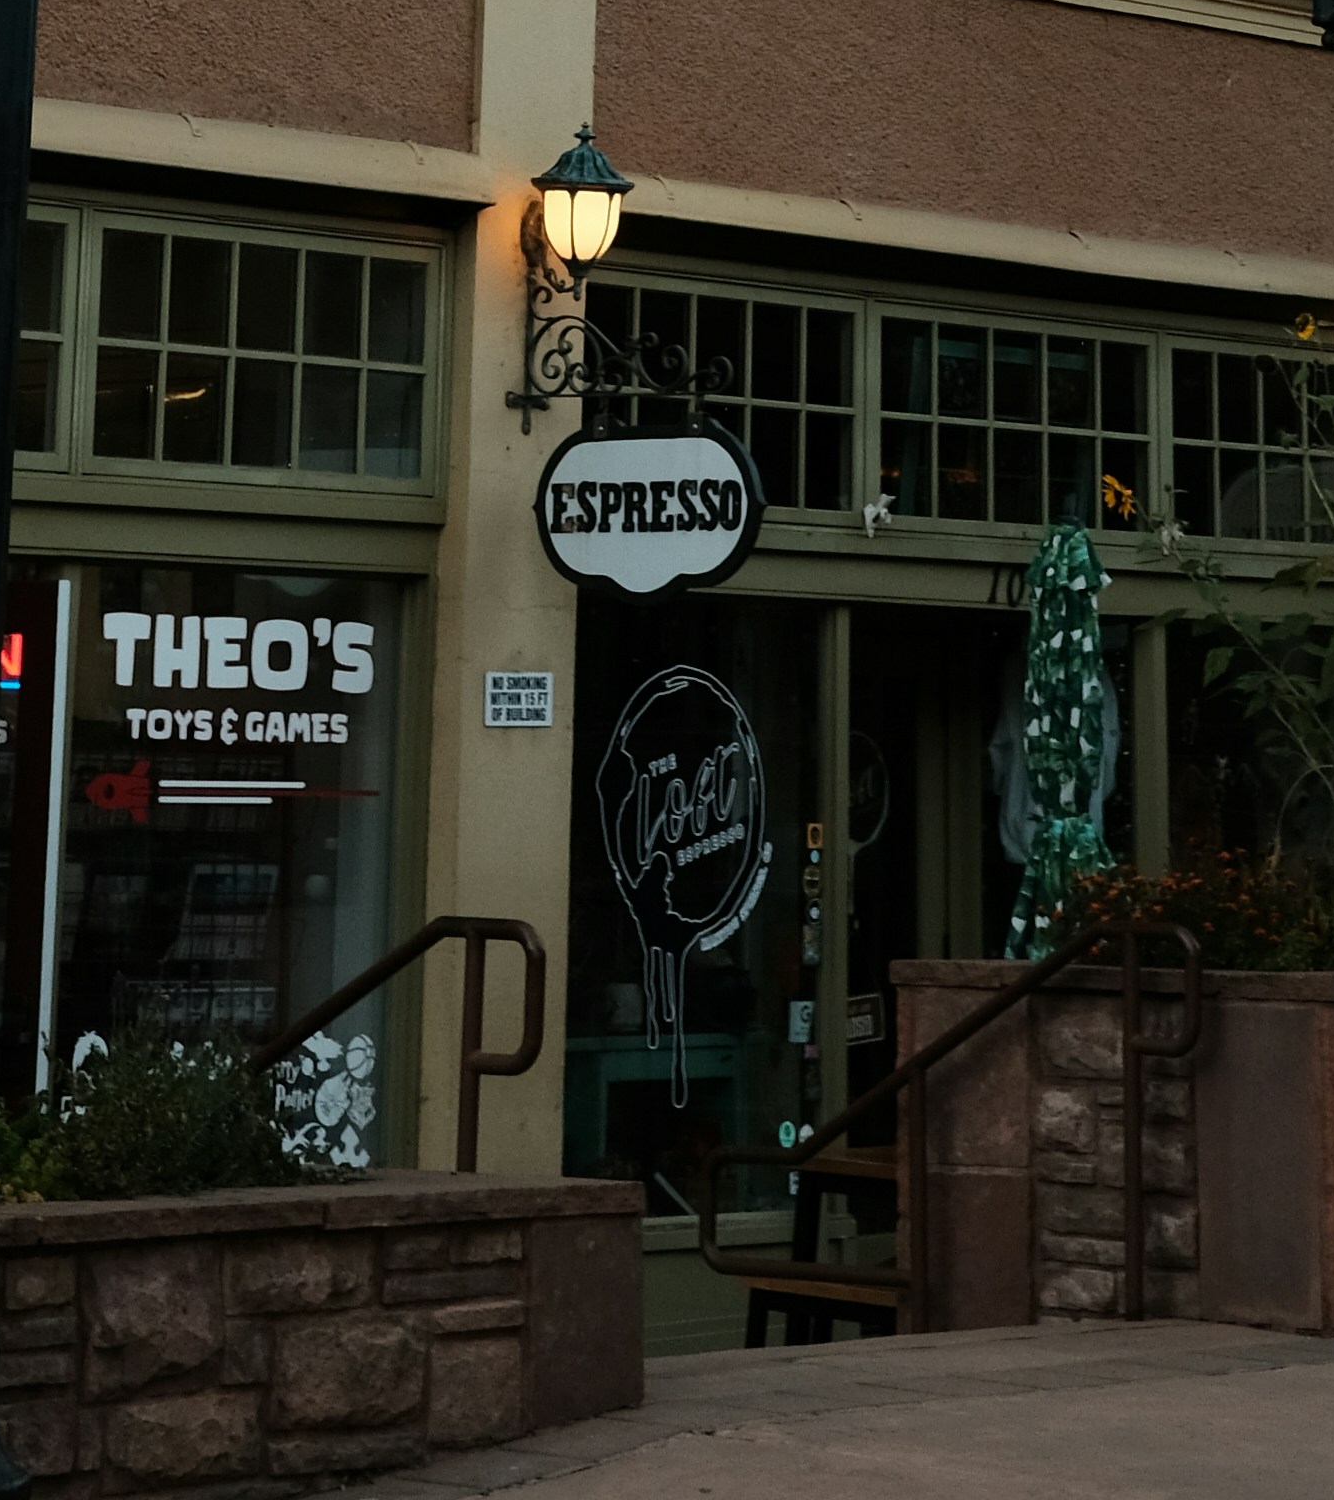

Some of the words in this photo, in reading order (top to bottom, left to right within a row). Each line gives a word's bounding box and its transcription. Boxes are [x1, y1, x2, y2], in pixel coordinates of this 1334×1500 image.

[550, 478, 743, 534] ESPRESSO
[103, 612, 375, 694] THEO'S
[126, 708, 213, 741] TOYS
[219, 707, 239, 745] &
[245, 711, 349, 743] GAMES
[648, 753, 678, 777] THE
